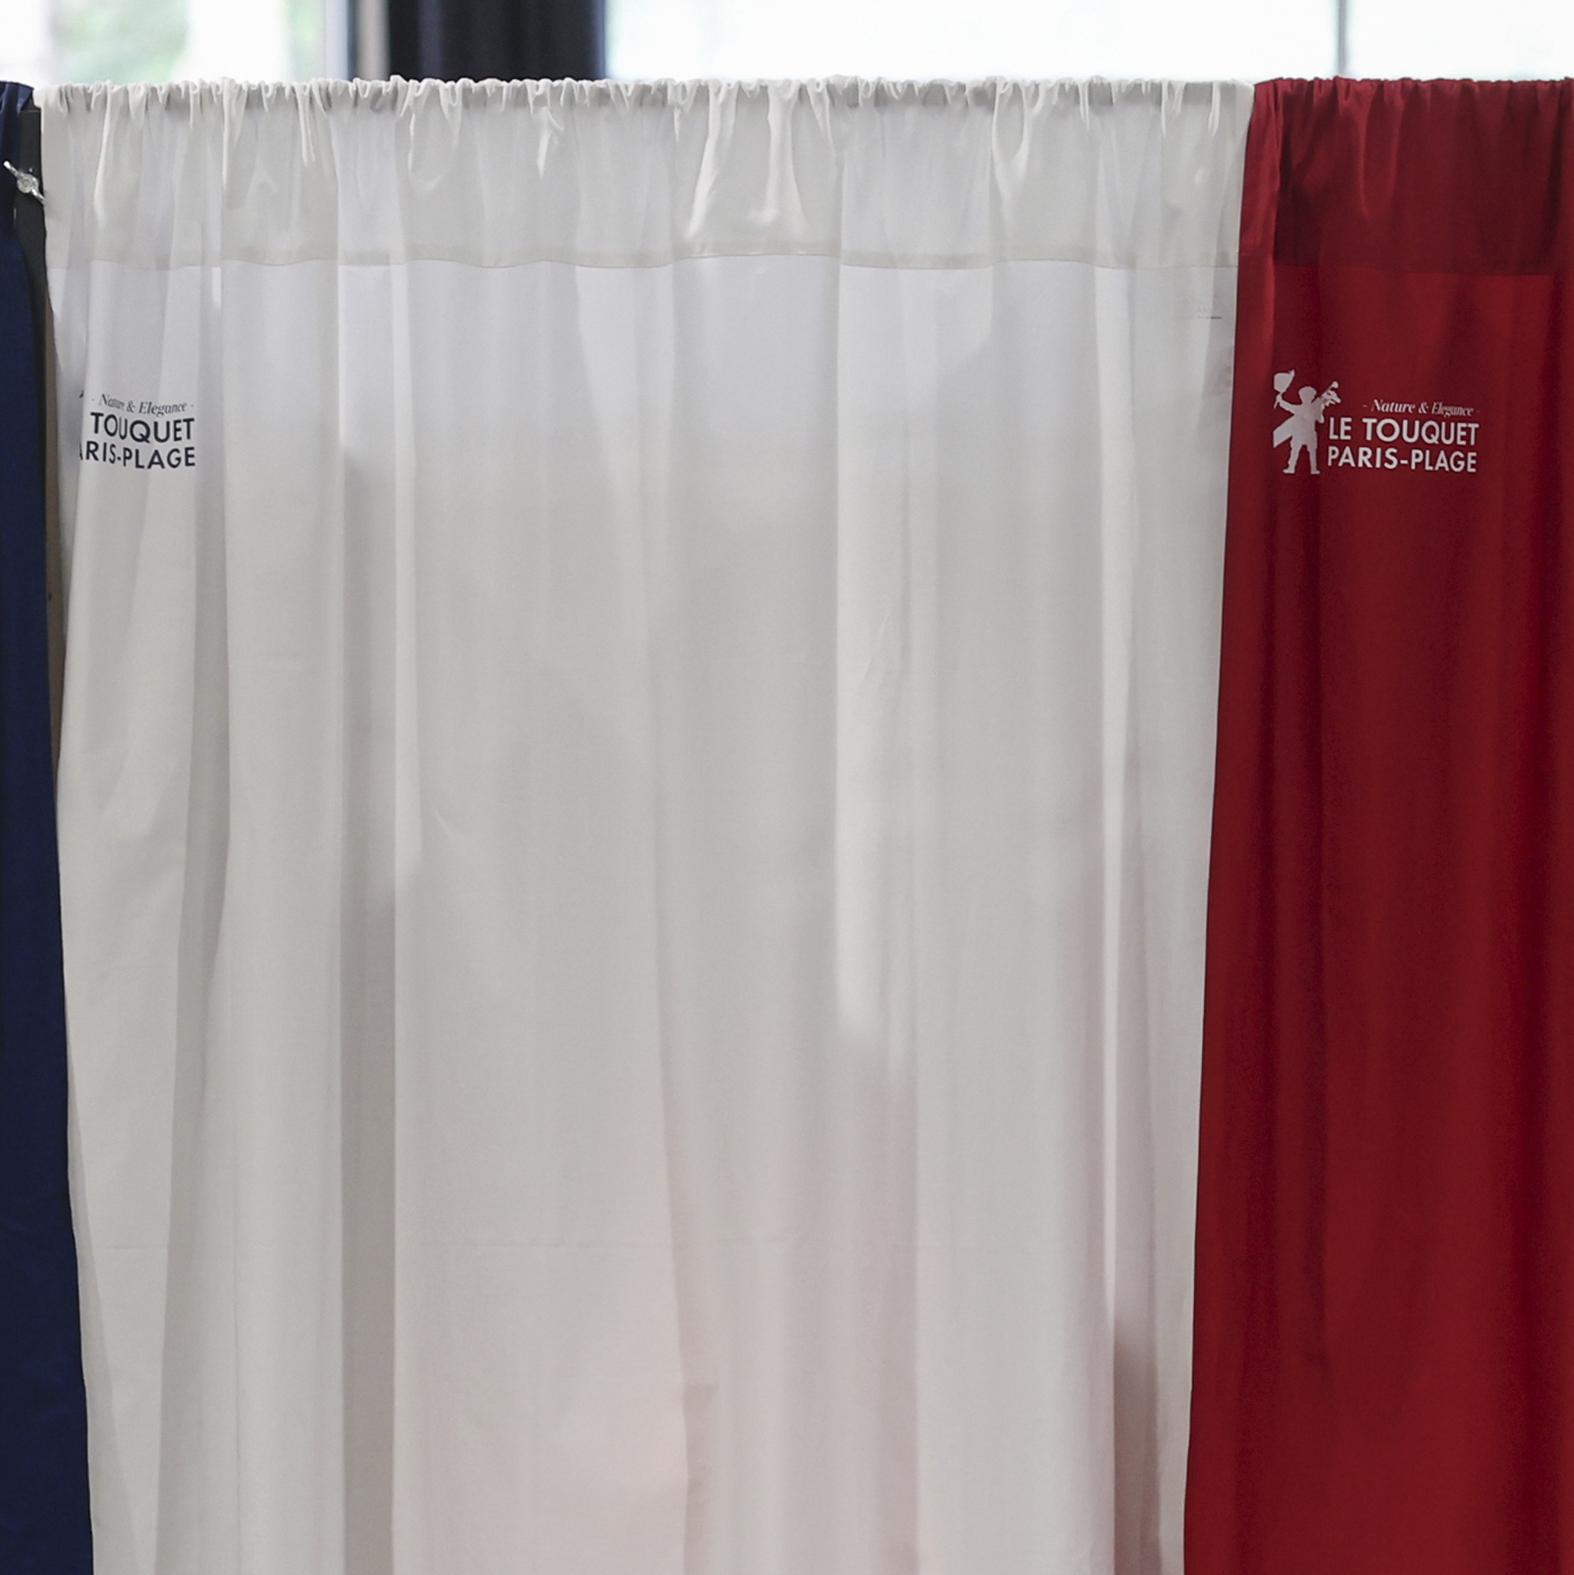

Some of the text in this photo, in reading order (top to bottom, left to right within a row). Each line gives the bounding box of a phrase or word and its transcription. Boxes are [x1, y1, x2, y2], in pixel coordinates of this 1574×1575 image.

[127, 401, 136, 413] &
[139, 402, 187, 417] Elegance
[1371, 399, 1474, 418] Nature & Elegance
[90, 412, 194, 443] TOUQUET
[1329, 417, 1479, 445] LE TOUQUET
[1328, 446, 1477, 472] PARIS-PLAGE
